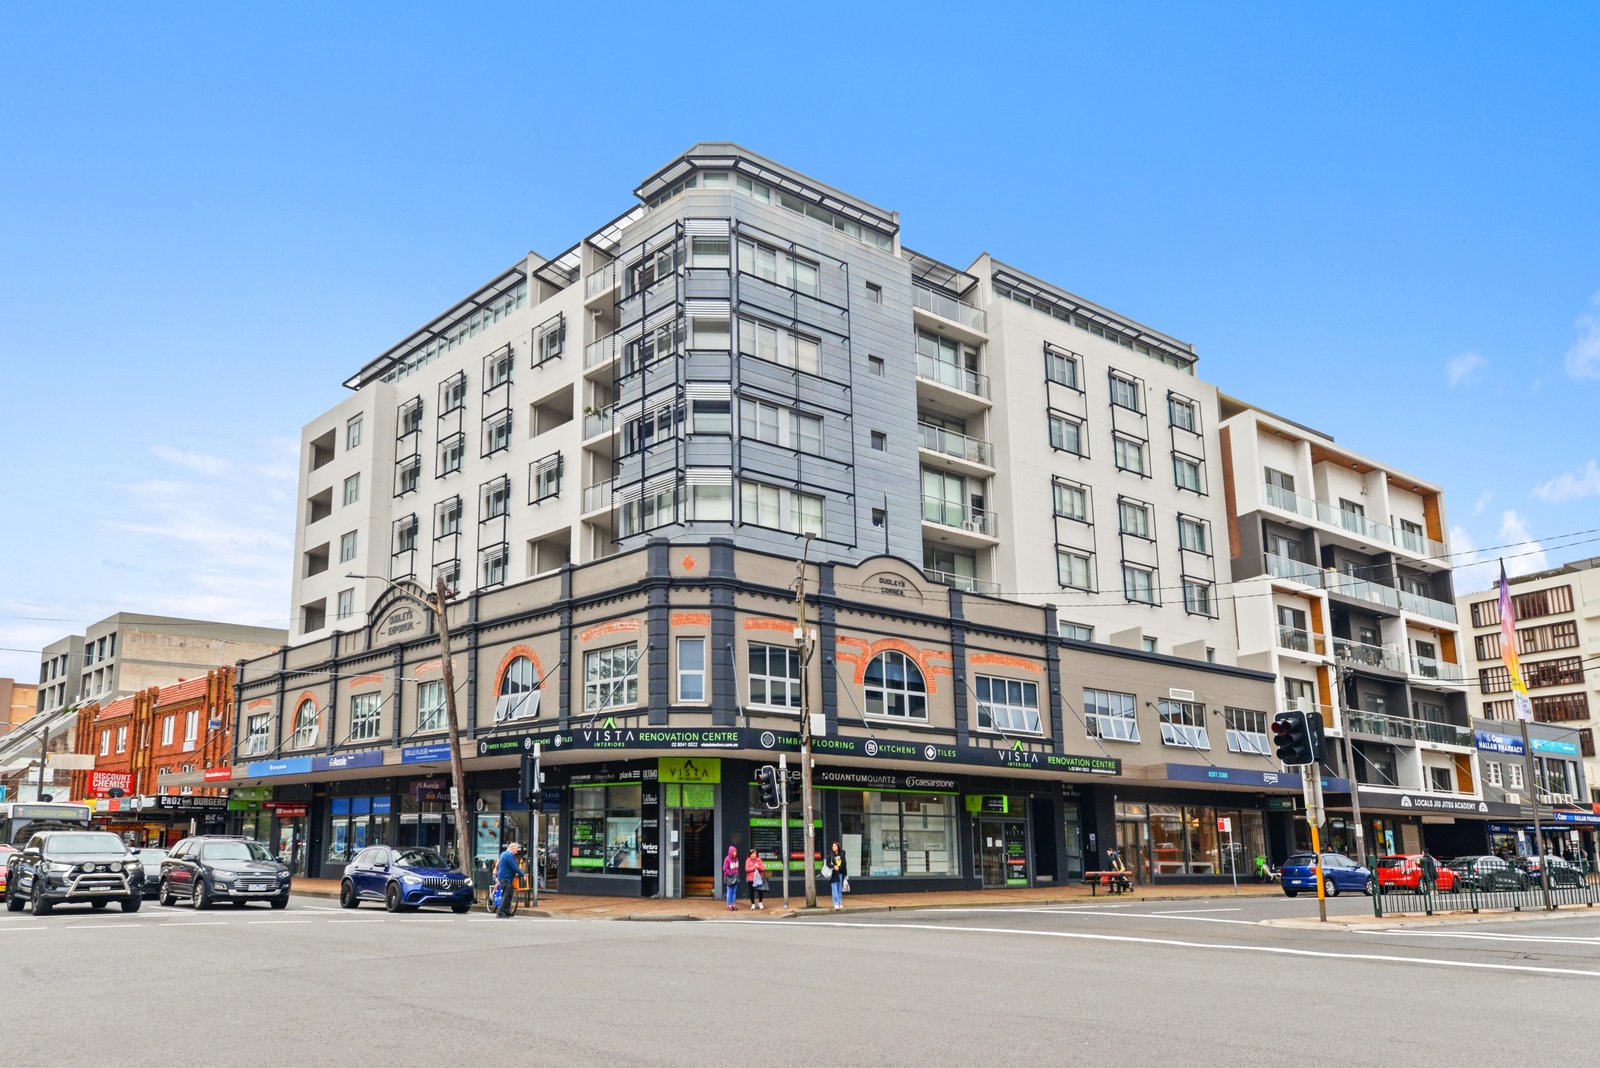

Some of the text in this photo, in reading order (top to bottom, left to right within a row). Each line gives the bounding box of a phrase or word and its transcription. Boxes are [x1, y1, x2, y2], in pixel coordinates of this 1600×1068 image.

[583, 730, 634, 742] VISTA
[639, 732, 738, 741] RENOVATION CENTRE
[812, 739, 855, 750] FLOORING
[879, 744, 916, 755] KITCHENS
[937, 748, 956, 758] TILES
[998, 750, 1038, 763] VISTA
[1048, 755, 1116, 769] RENOVATION CENTRE
[93, 772, 132, 781] DISCOUNT
[619, 770, 633, 780] plank
[670, 768, 708, 777] VISTA
[829, 774, 896, 784] QUANTUMQUARTZ
[915, 778, 954, 788] caesarstone
[92, 780, 131, 789] CHEMIST
[193, 797, 227, 806] BURGERS
[1414, 799, 1433, 807] LOCALS
[1442, 801, 1454, 809] JITSU
[1454, 802, 1476, 810] ACADEMY
